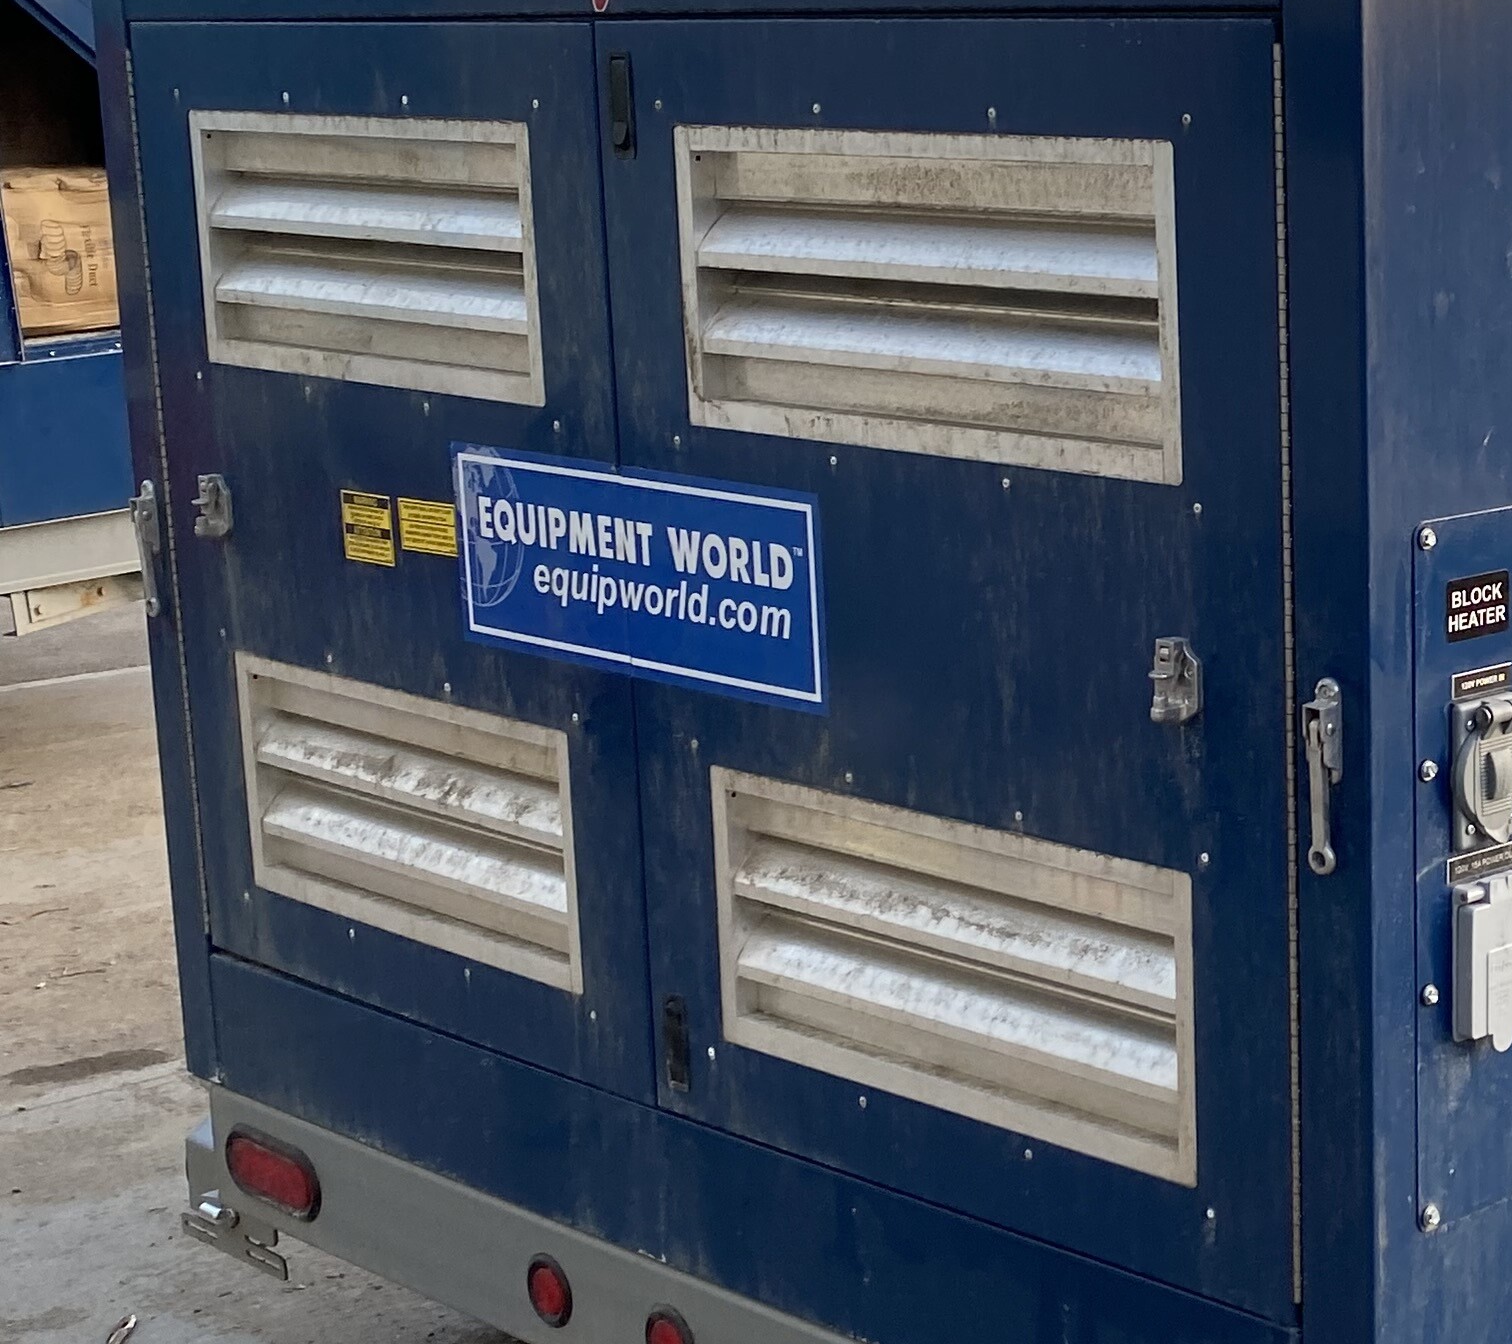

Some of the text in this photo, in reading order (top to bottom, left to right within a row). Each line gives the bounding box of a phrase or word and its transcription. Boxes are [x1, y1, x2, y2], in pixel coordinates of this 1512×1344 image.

[477, 496, 653, 566] EQUIPMENT
[533, 563, 792, 639] equipworld.com
[1448, 605, 1506, 633] HEATER
[1451, 581, 1503, 609] BLOCK
